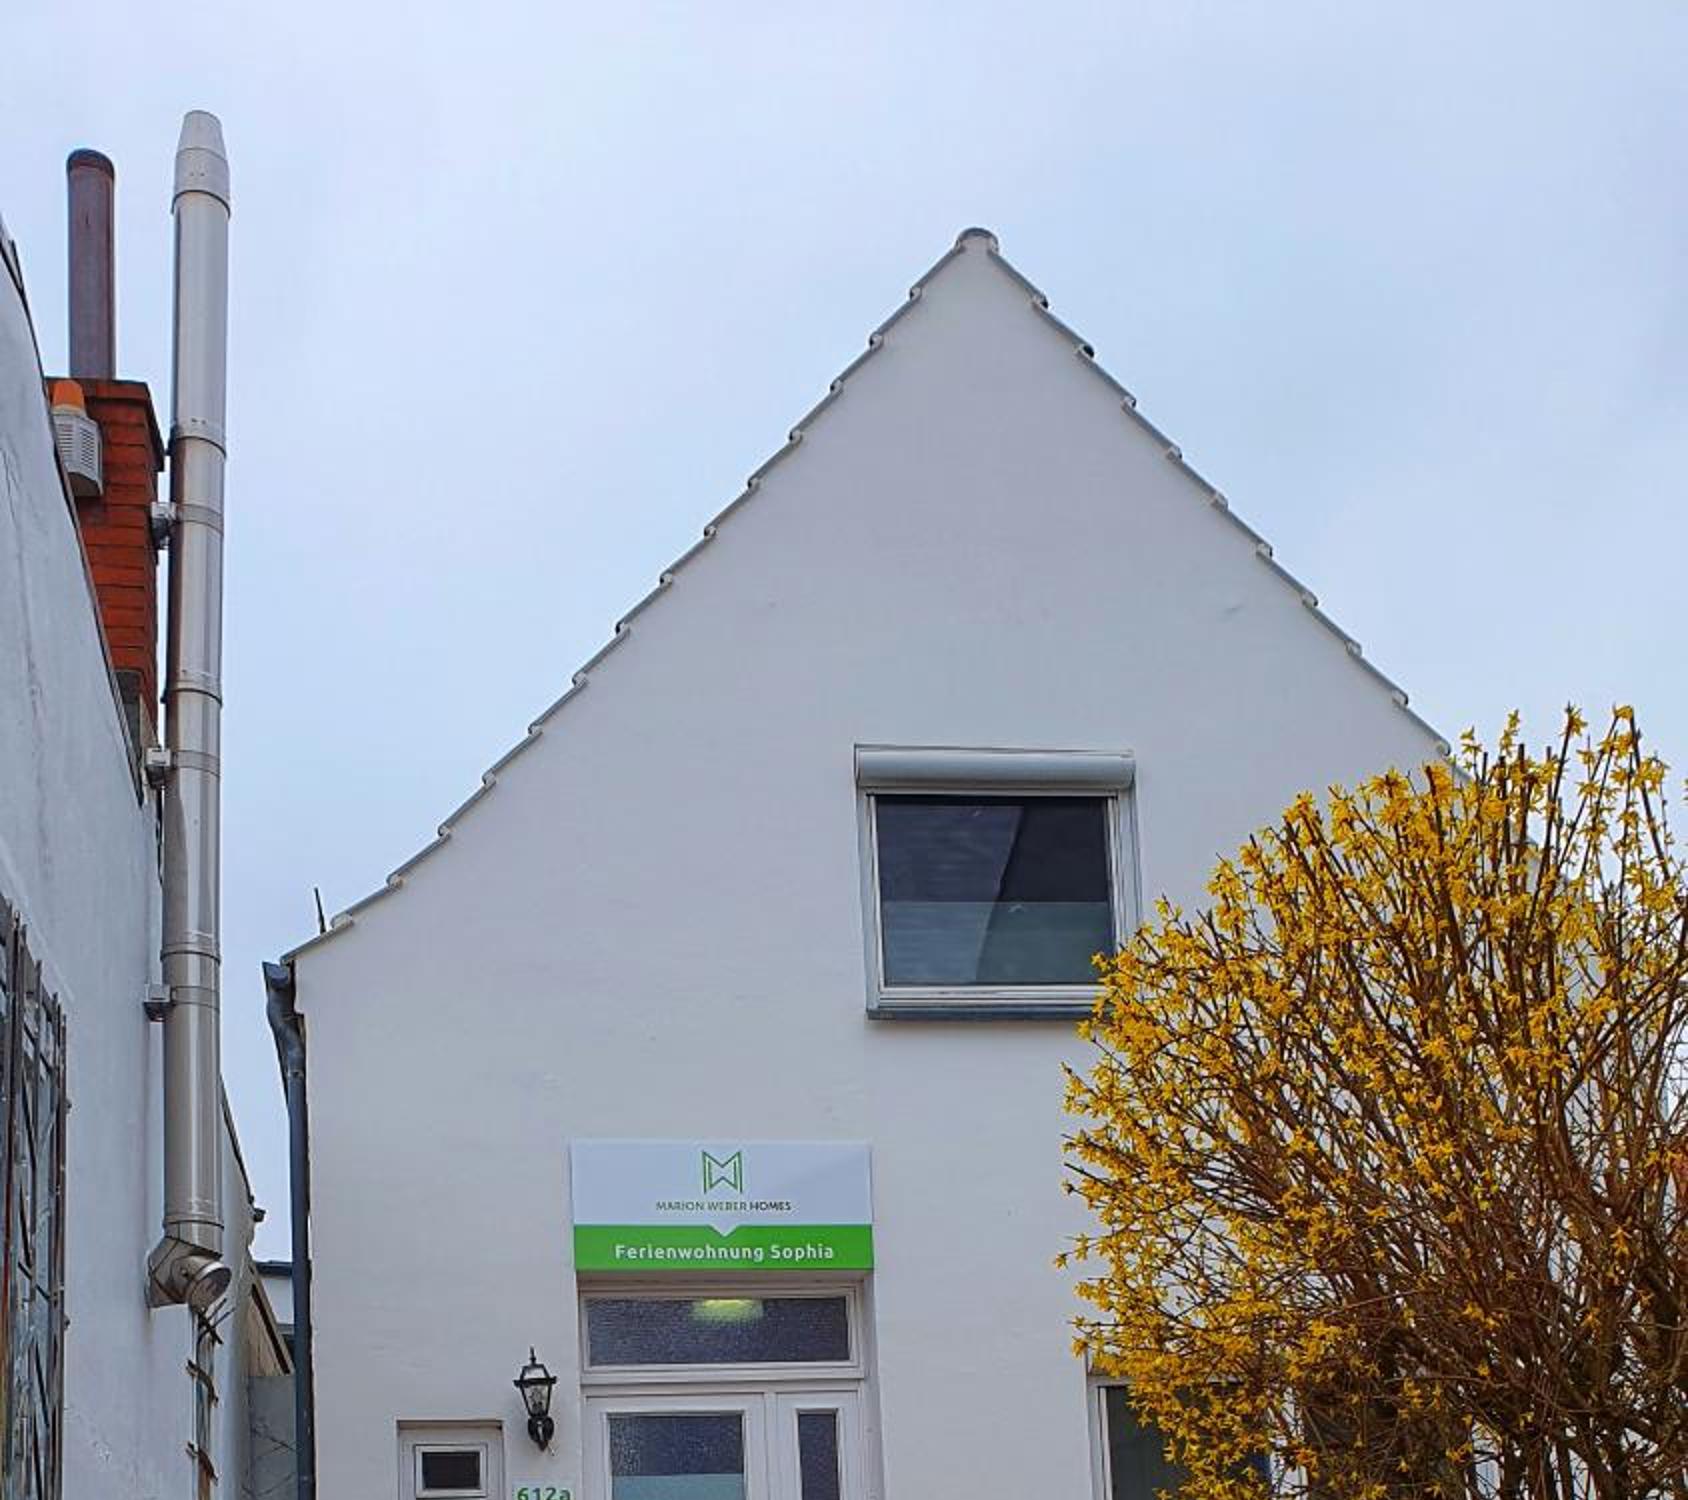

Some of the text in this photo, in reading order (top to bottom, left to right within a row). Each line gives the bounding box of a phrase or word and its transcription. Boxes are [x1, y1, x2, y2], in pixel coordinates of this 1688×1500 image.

[656, 1201, 791, 1211] MARION WEBER HOMES
[615, 1244, 833, 1261] Ferienwohnung Sophia
